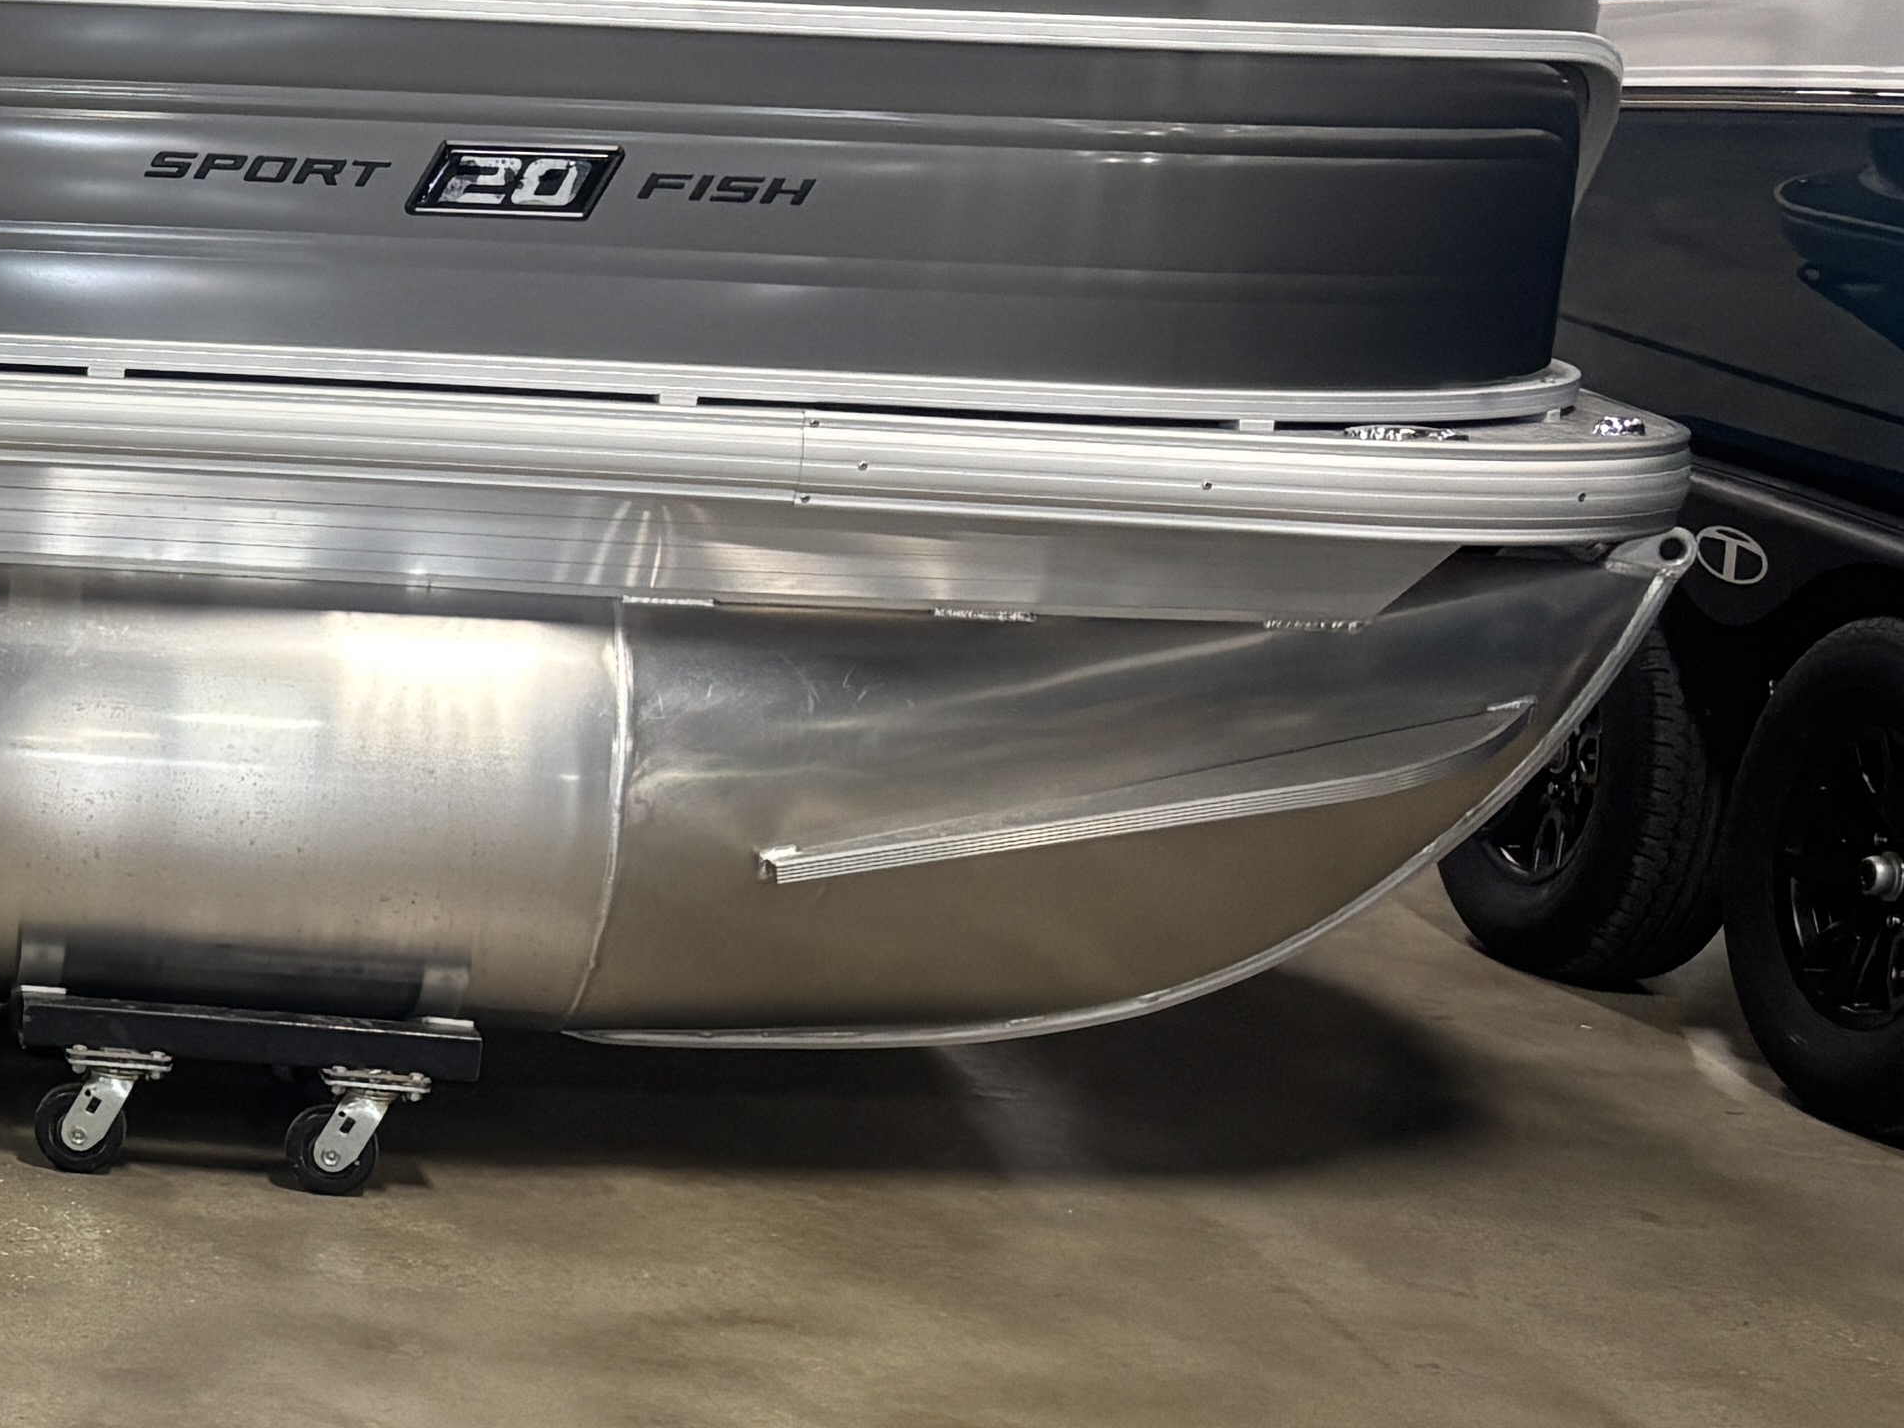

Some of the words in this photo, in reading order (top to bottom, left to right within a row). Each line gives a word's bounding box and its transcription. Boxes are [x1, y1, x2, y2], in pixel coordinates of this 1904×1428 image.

[143, 150, 392, 188] SPORT
[442, 155, 590, 207] 20
[637, 172, 817, 206] FISH
